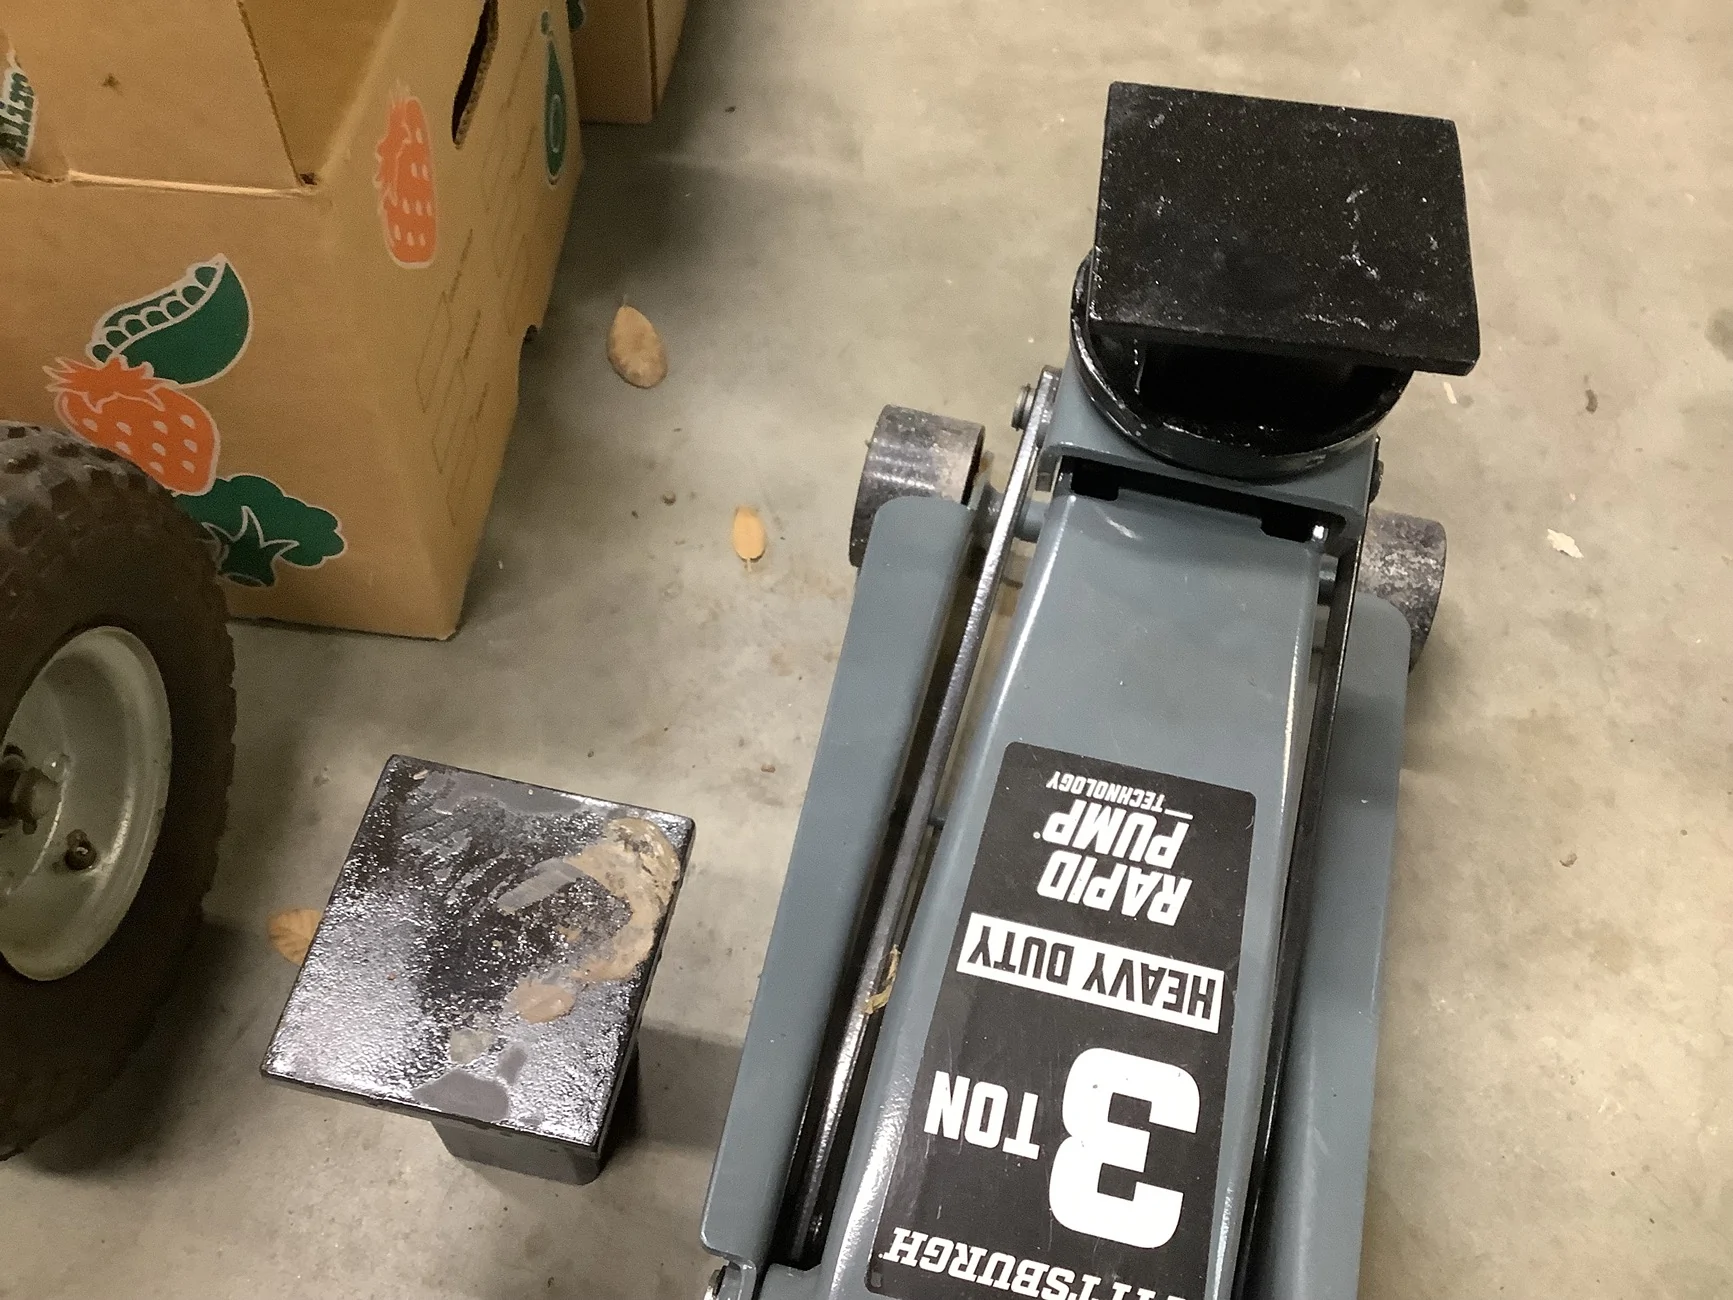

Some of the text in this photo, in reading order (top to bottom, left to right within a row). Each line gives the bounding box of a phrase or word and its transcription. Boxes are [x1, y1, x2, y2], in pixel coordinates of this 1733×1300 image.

[1045, 770, 1166, 813] TECHNOLOGY
[1042, 798, 1190, 869] PUMP
[1036, 849, 1193, 927] RAPID
[967, 925, 1216, 1020] HEAVY DUTY
[923, 1048, 1200, 1248] 3 TON
[881, 1227, 1186, 1300] TSBURGH
